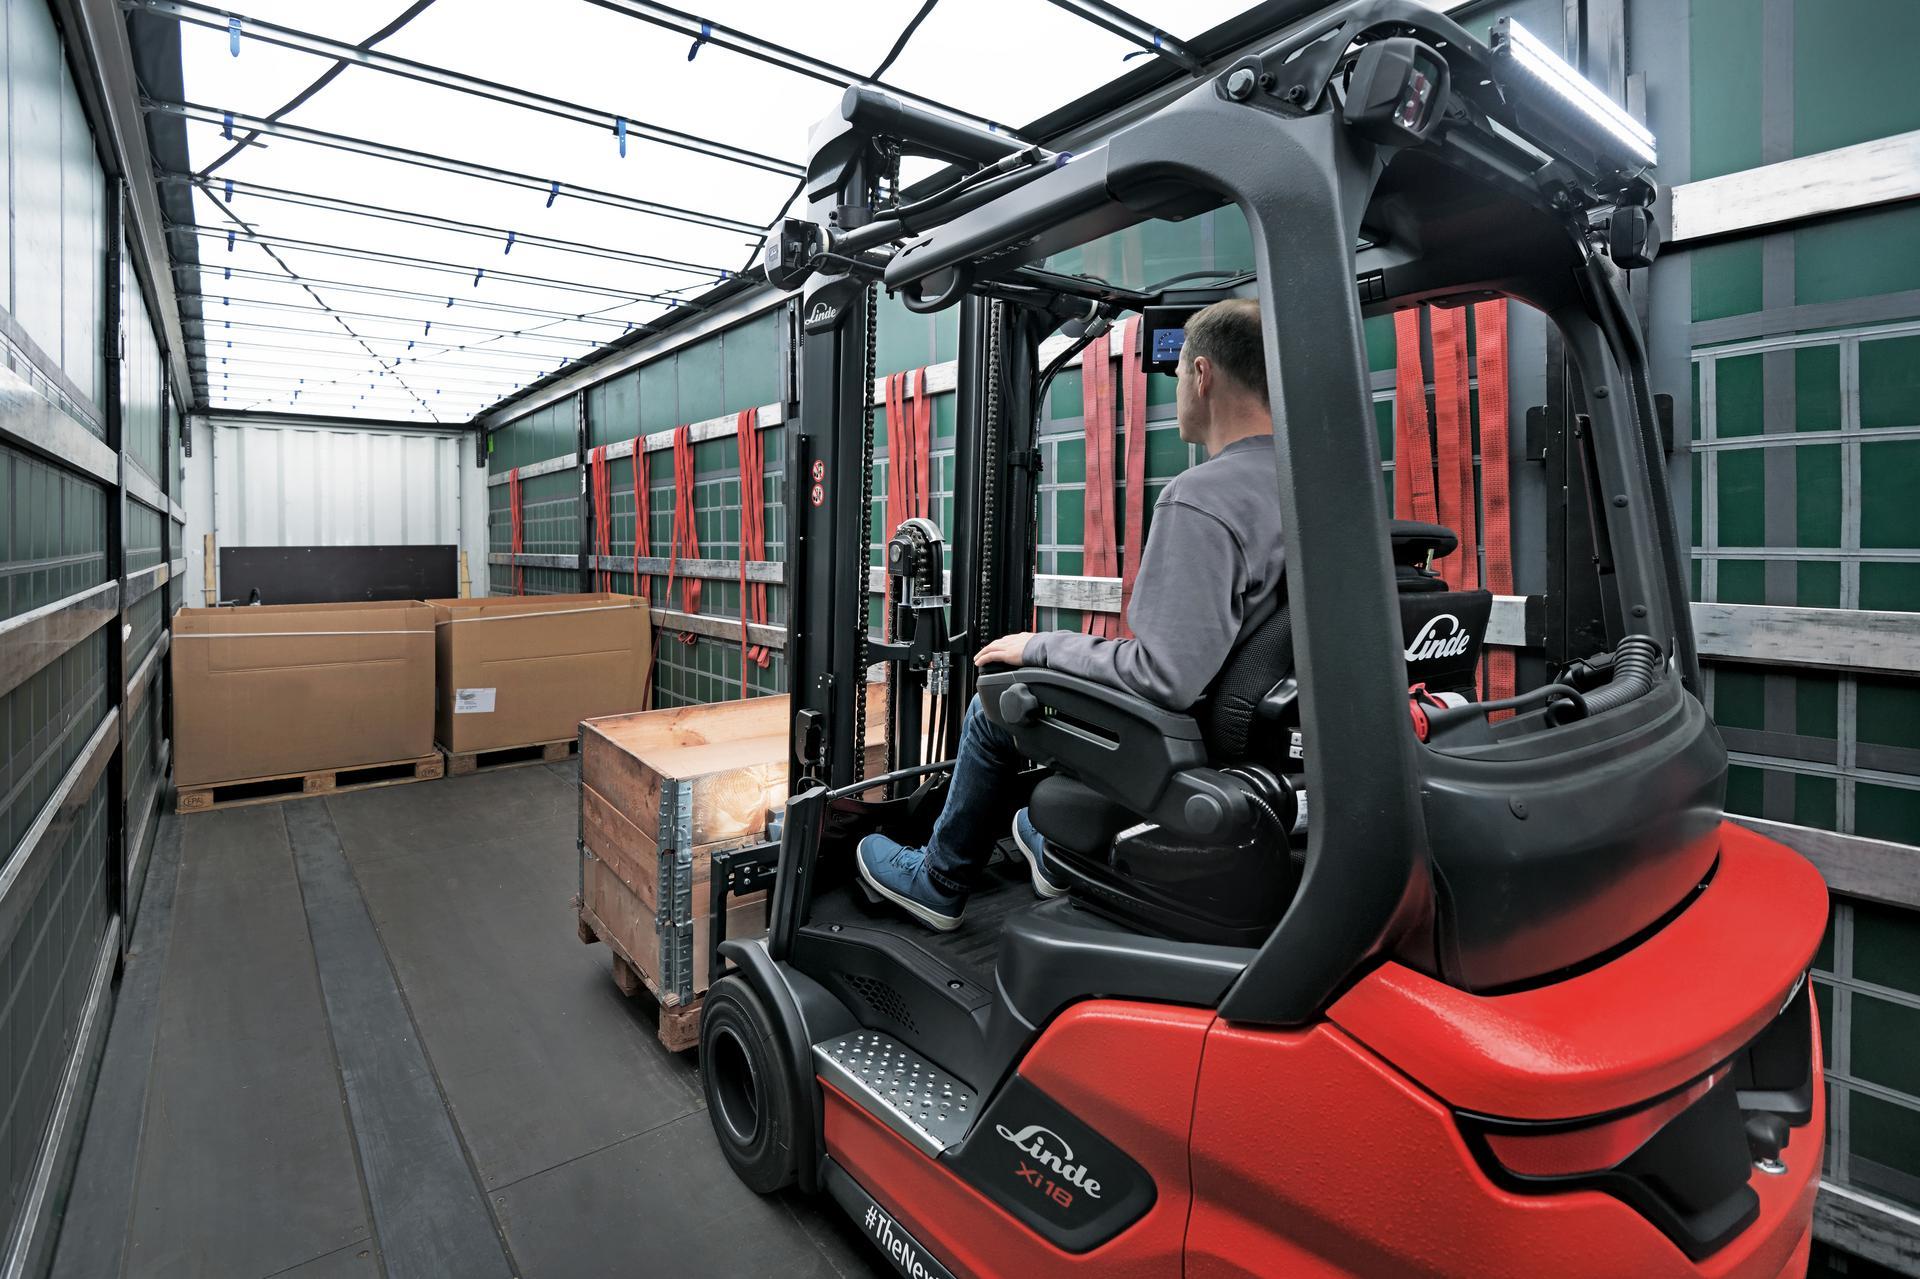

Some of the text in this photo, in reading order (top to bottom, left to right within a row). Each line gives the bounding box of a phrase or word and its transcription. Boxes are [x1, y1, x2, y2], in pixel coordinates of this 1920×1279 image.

[804, 302, 838, 326] Linde
[1403, 613, 1470, 662] Linde
[995, 1124, 1101, 1199] Linde
[1015, 1160, 1075, 1208] Xi18
